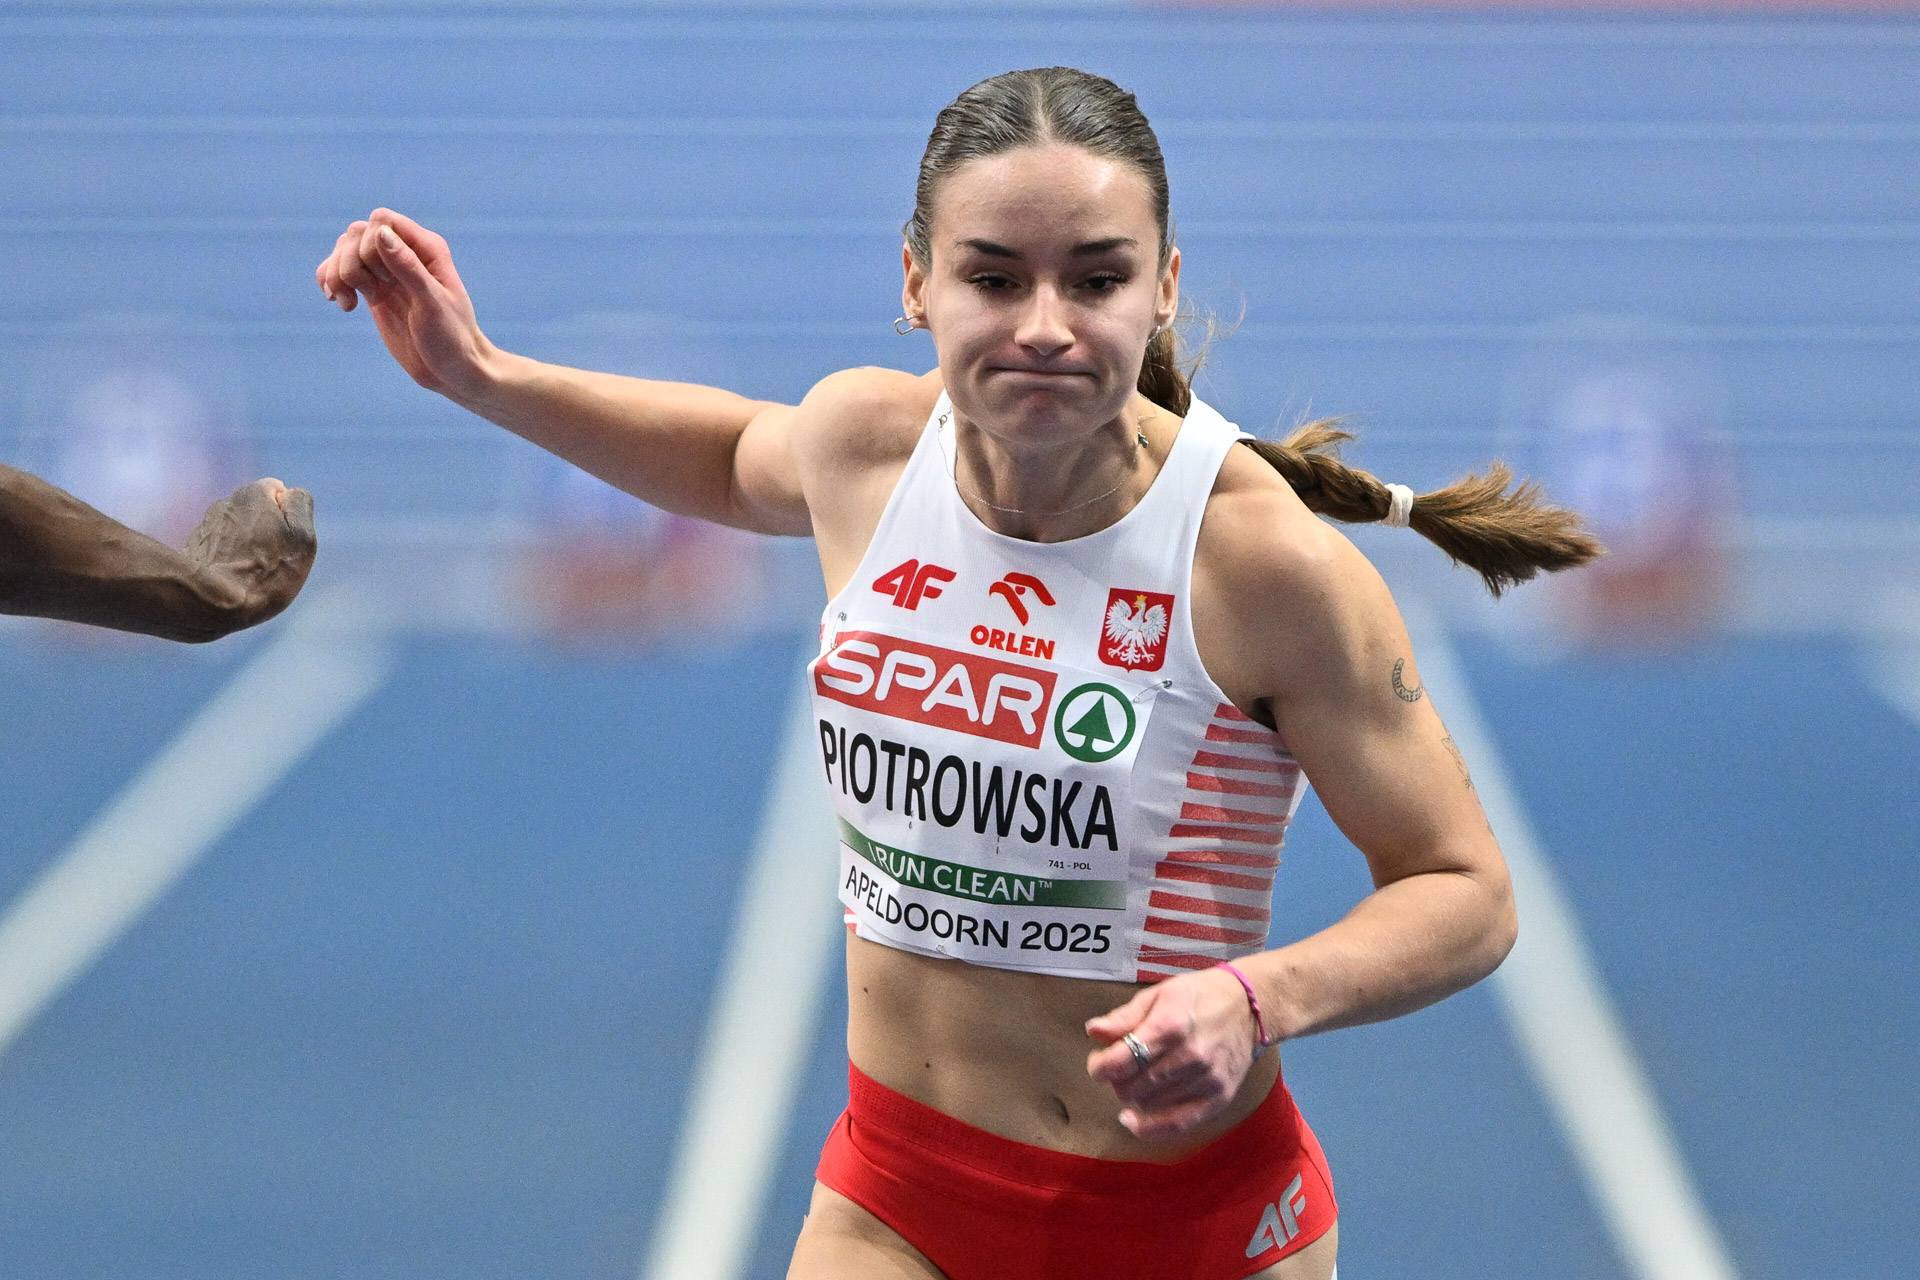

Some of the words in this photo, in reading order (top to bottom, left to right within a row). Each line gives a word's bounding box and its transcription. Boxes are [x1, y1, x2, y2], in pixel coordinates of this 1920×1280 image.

[871, 558, 957, 611] 4F
[970, 624, 1055, 661] ORLEN
[821, 640, 1045, 735] SPAR
[819, 719, 1119, 851] PIOTROWSKA
[875, 845, 926, 884] RUN
[1048, 860, 1065, 869] 741
[1073, 862, 1092, 870] POL
[845, 865, 1009, 949] APELDOORN
[1020, 921, 1112, 953] 2025
[1245, 1172, 1306, 1258] 4F
